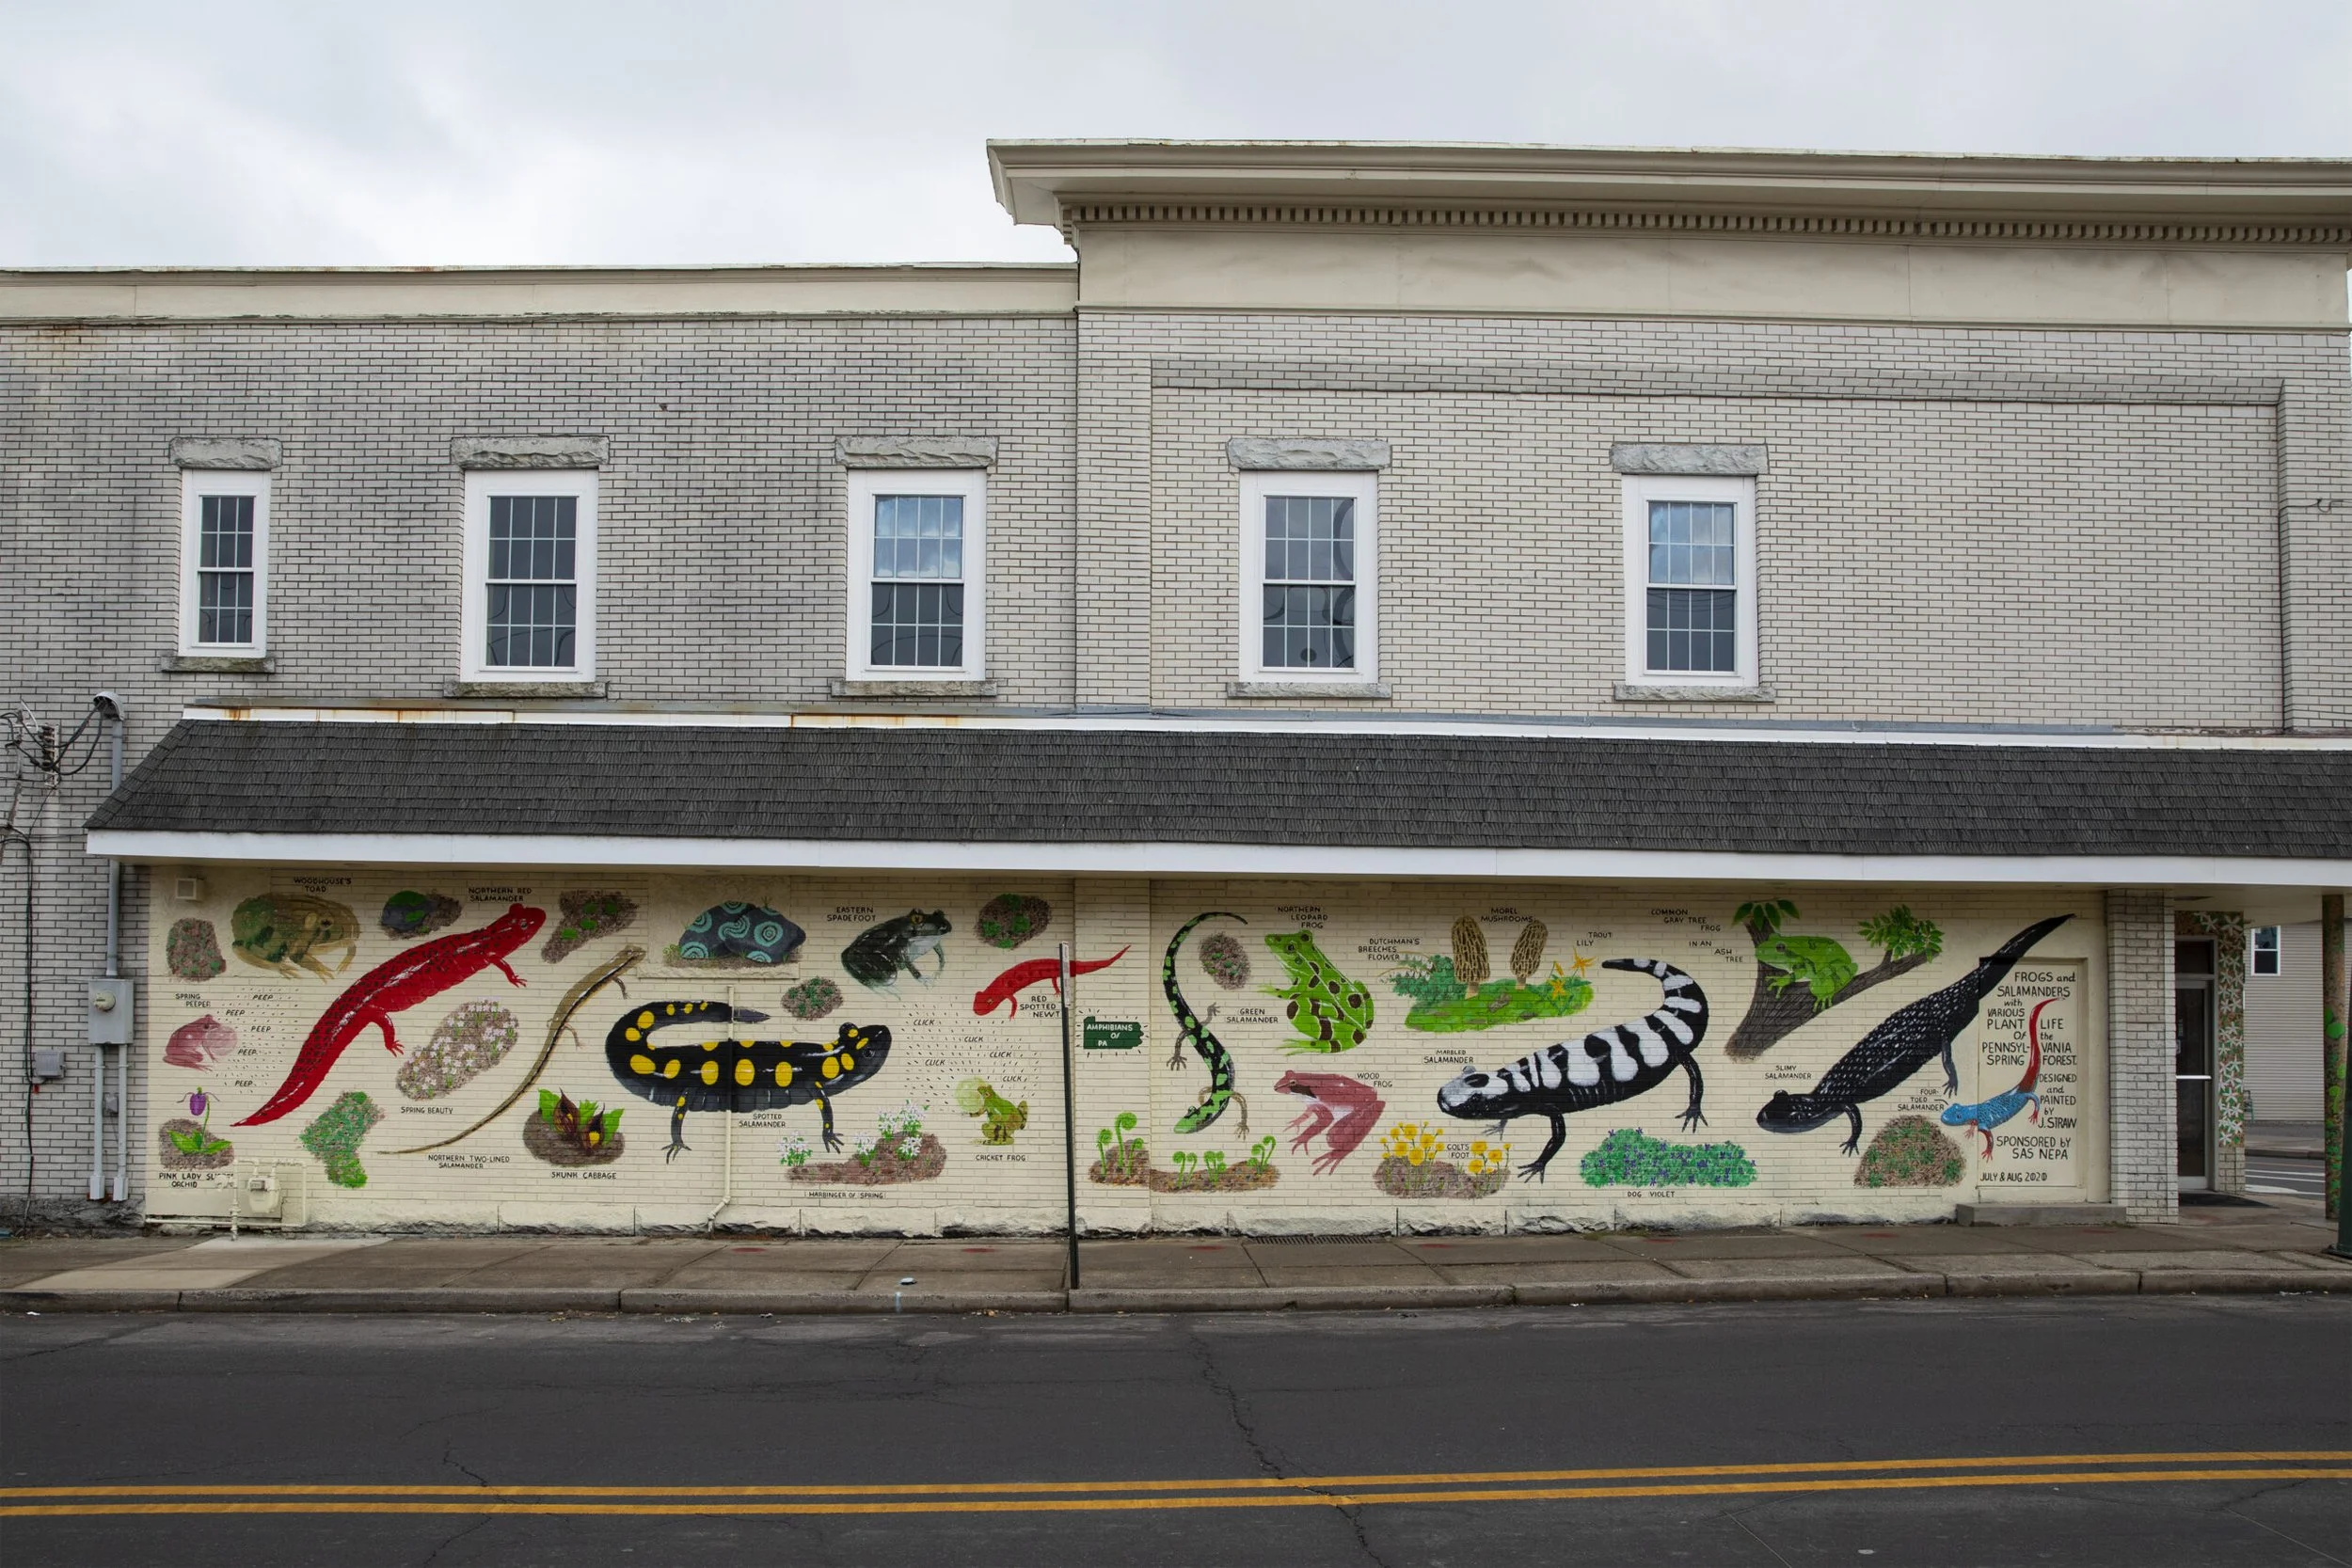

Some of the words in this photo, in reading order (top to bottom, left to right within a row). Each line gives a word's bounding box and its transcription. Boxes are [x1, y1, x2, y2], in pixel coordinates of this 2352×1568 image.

[1490, 907, 1518, 915] MOREL
[1291, 913, 1328, 922] LEOPARD
[1688, 916, 1708, 925] TREE
[1301, 921, 1324, 929] FROG
[1700, 924, 1721, 932] FROG
[2014, 971, 2054, 983] FROGS
[2056, 971, 2077, 983] and
[1996, 985, 2071, 998] SALAMANDERS
[175, 992, 201, 1001] SPRING
[252, 993, 274, 1002] PEEP
[185, 1000, 211, 1008] PEEPER
[2003, 998, 2023, 1006] with
[1019, 1003, 1057, 1011] SPOTTED
[1239, 1007, 1265, 1016] GREEN
[225, 1008, 246, 1017] PEEP
[1987, 1007, 2026, 1018] VARIOUS
[1226, 1016, 1279, 1024] SALAMANDER
[1987, 1018, 2026, 1030] PLANT
[2040, 1018, 2064, 1030] LIFE
[250, 1024, 272, 1033] PEEP
[1086, 1022, 1134, 1032] AMPHIBIANS
[2040, 1031, 2054, 1041] the
[1981, 1041, 2030, 1053] PENNSYL-
[2041, 1041, 2073, 1053] VANIA
[237, 1048, 258, 1056] PEEP
[925, 1058, 946, 1067] CLICK
[1423, 1055, 1474, 1064] SALAMANDER
[1986, 1054, 2026, 1066] SPRING
[2039, 1073, 2077, 1083] DESIGNED
[234, 1079, 253, 1087] PEEP
[1374, 1080, 1393, 1088] FROG
[2046, 1085, 2065, 1094] and
[2040, 1094, 2077, 1106] PAINTED
[427, 1106, 453, 1115] BEAUTY
[1897, 1103, 1945, 1112] SALAMANDER
[739, 1120, 787, 1129] SALAMANDER
[1996, 1135, 2057, 1148] SPONSORED
[2012, 1148, 2034, 1160] SAS
[2039, 1148, 2069, 1161] NEPA
[469, 1155, 510, 1164] TWO-LINED
[582, 1171, 617, 1180] CABBAGE
[1979, 1172, 1998, 1181] JULY
[2007, 1171, 2024, 1182] AUG
[2025, 1171, 2048, 1181] 2020
[171, 1180, 198, 1189] ORCHID
[809, 1191, 847, 1199] HARBINGER
